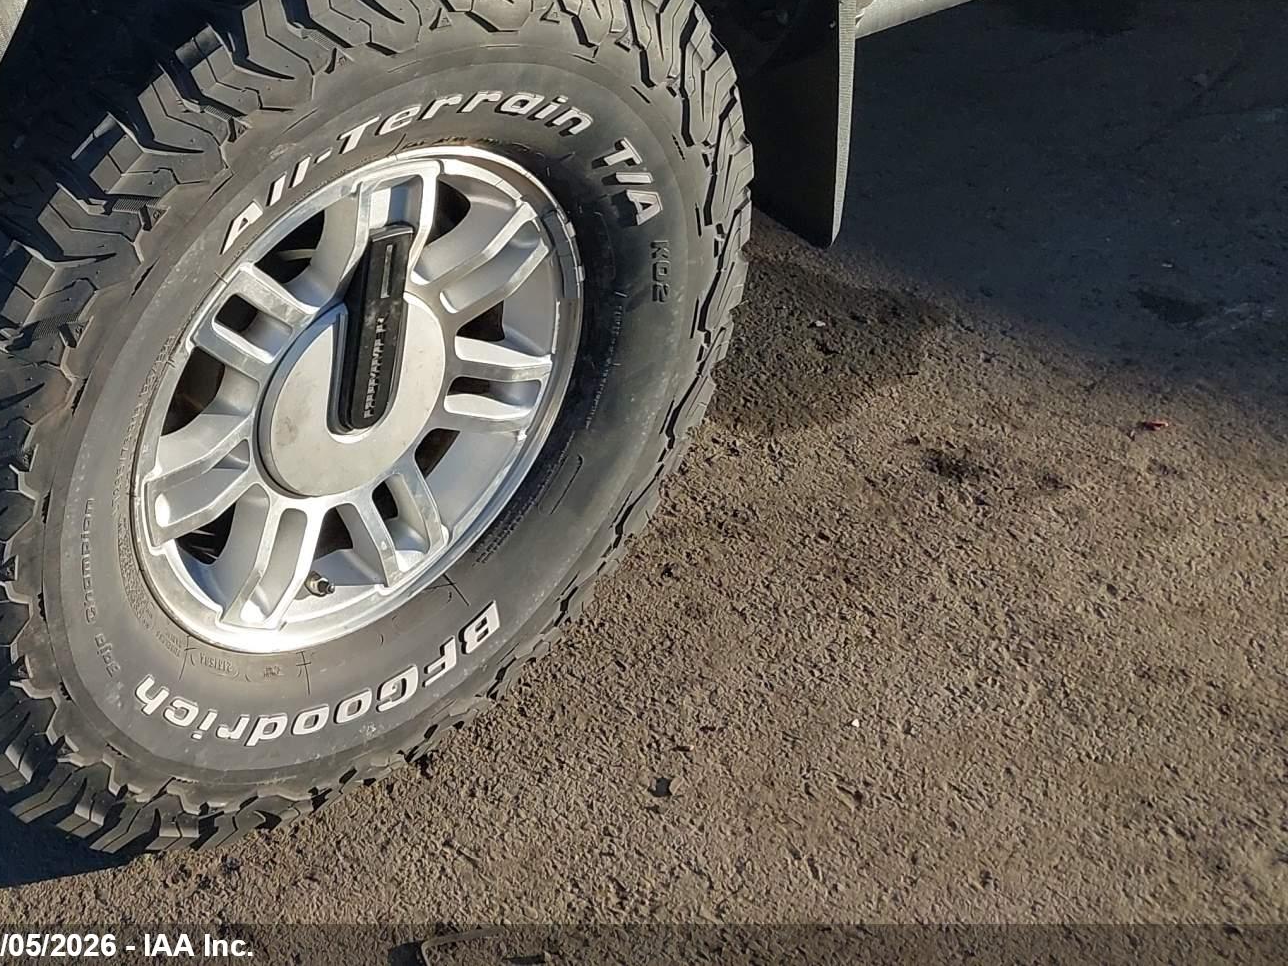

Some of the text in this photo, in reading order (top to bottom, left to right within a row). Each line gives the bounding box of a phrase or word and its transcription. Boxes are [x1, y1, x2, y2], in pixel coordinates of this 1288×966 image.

[220, 90, 594, 255] All-Terrain
[595, 137, 663, 226] T/A
[81, 497, 97, 624] Champion
[134, 600, 501, 747] BFGoodrich
